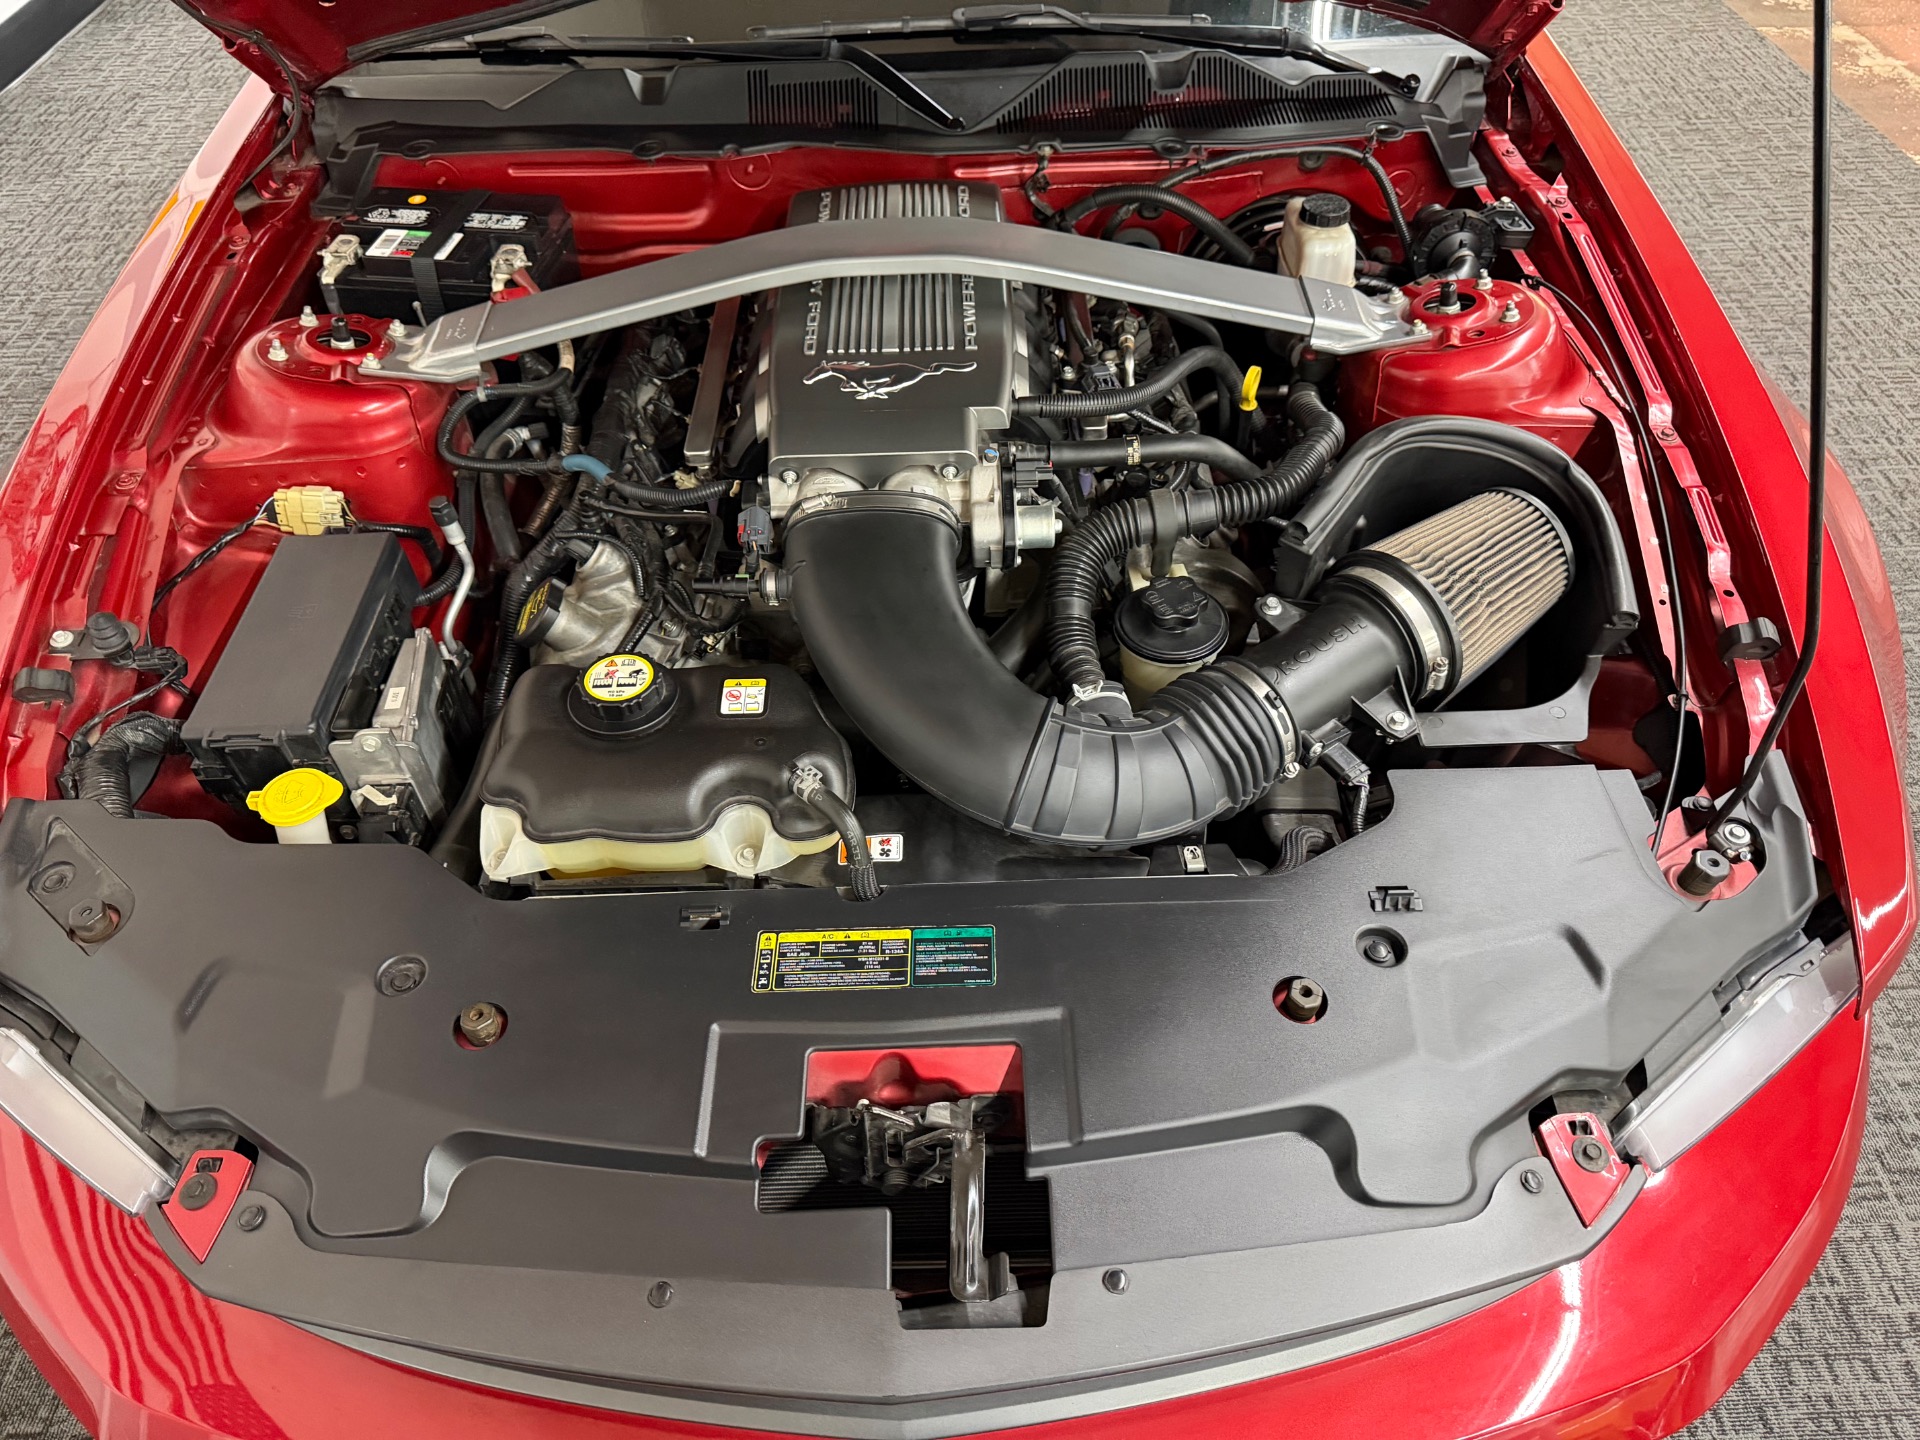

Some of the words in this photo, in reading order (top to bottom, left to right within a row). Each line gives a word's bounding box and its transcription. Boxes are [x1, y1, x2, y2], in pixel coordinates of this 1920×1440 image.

[818, 191, 832, 223] POW
[957, 185, 970, 218] ORD
[803, 301, 822, 356] FORD
[961, 274, 978, 351] POWERE
[1277, 615, 1368, 676] ROUSH
